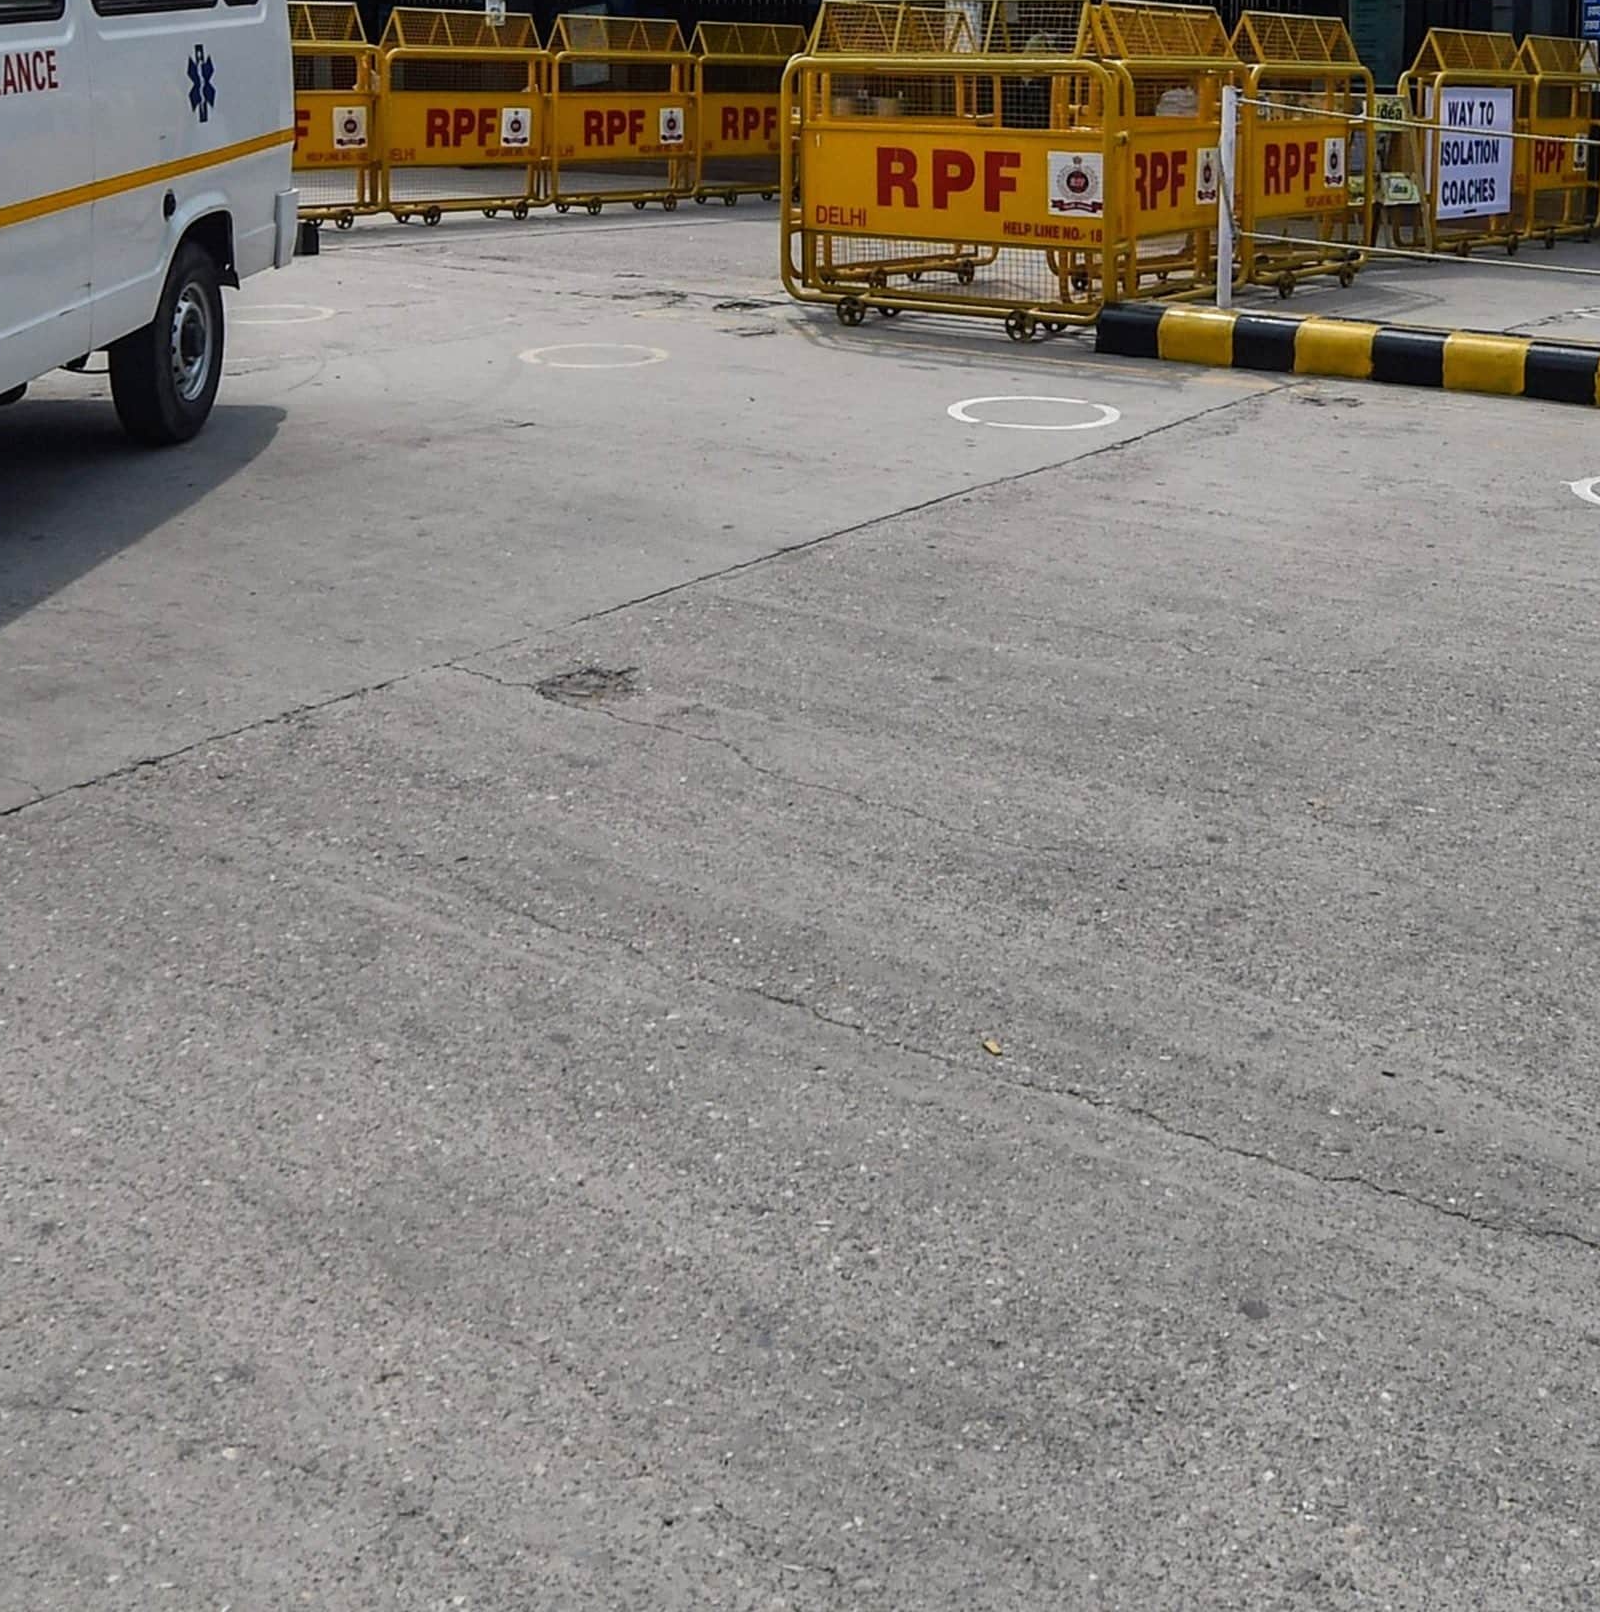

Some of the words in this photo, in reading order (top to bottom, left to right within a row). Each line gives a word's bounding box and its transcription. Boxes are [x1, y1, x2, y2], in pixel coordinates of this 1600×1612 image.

[426, 108, 497, 148] RPF
[583, 109, 646, 146] RPF
[721, 106, 777, 140] RPF
[1448, 101, 1474, 126] WAY
[1479, 101, 1494, 126] TO
[1264, 141, 1318, 196] RPF
[1440, 140, 1499, 166] ISOLATION
[1534, 139, 1566, 173] RPF
[877, 146, 1021, 212] RPF
[1441, 178, 1496, 206] COACHES
[815, 205, 867, 228] DELHI
[1003, 220, 1032, 237] HELP
[1034, 223, 1060, 238] LINE
